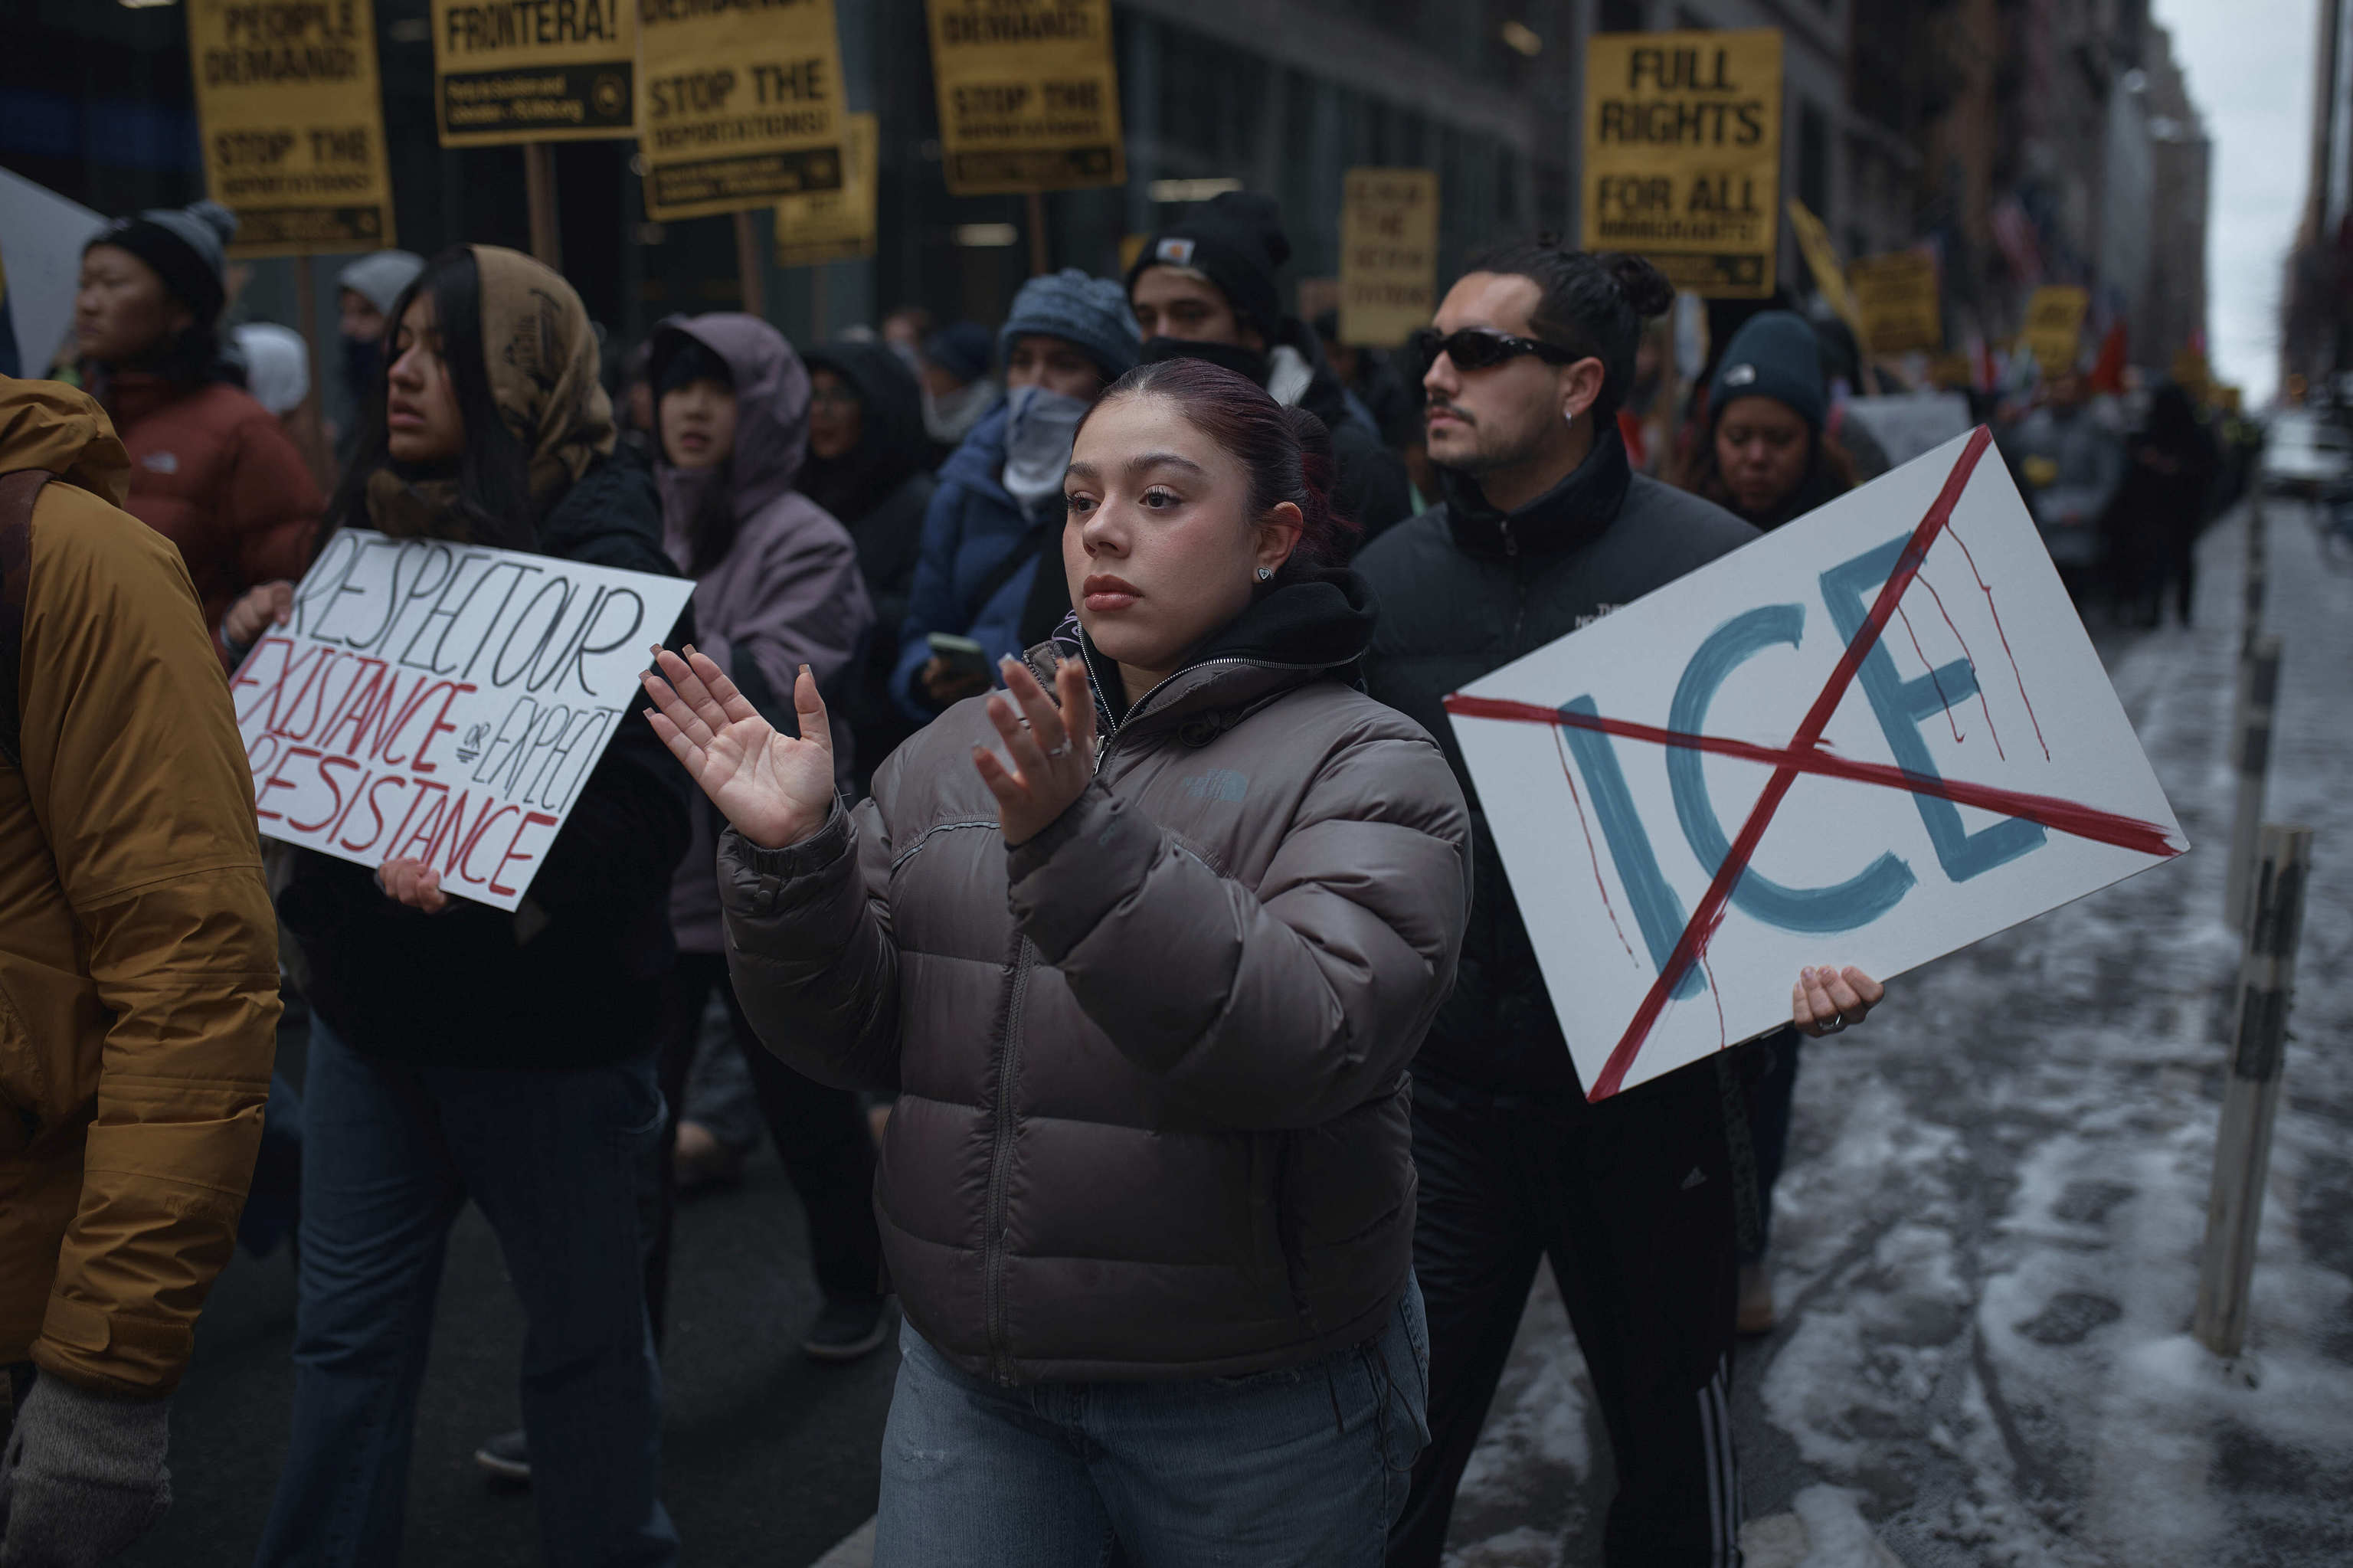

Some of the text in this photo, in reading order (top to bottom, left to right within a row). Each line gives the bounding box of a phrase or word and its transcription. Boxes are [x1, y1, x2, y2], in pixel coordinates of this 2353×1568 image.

[447, 0, 617, 54] FRONTERA!
[650, 57, 826, 119] STOP THE
[1629, 46, 1738, 92] FULL
[1599, 100, 1764, 146] RIGHTS
[1598, 170, 1759, 218] FOR ALL
[472, 696, 623, 813] EXPECT
[1557, 530, 2050, 1002] ICE
